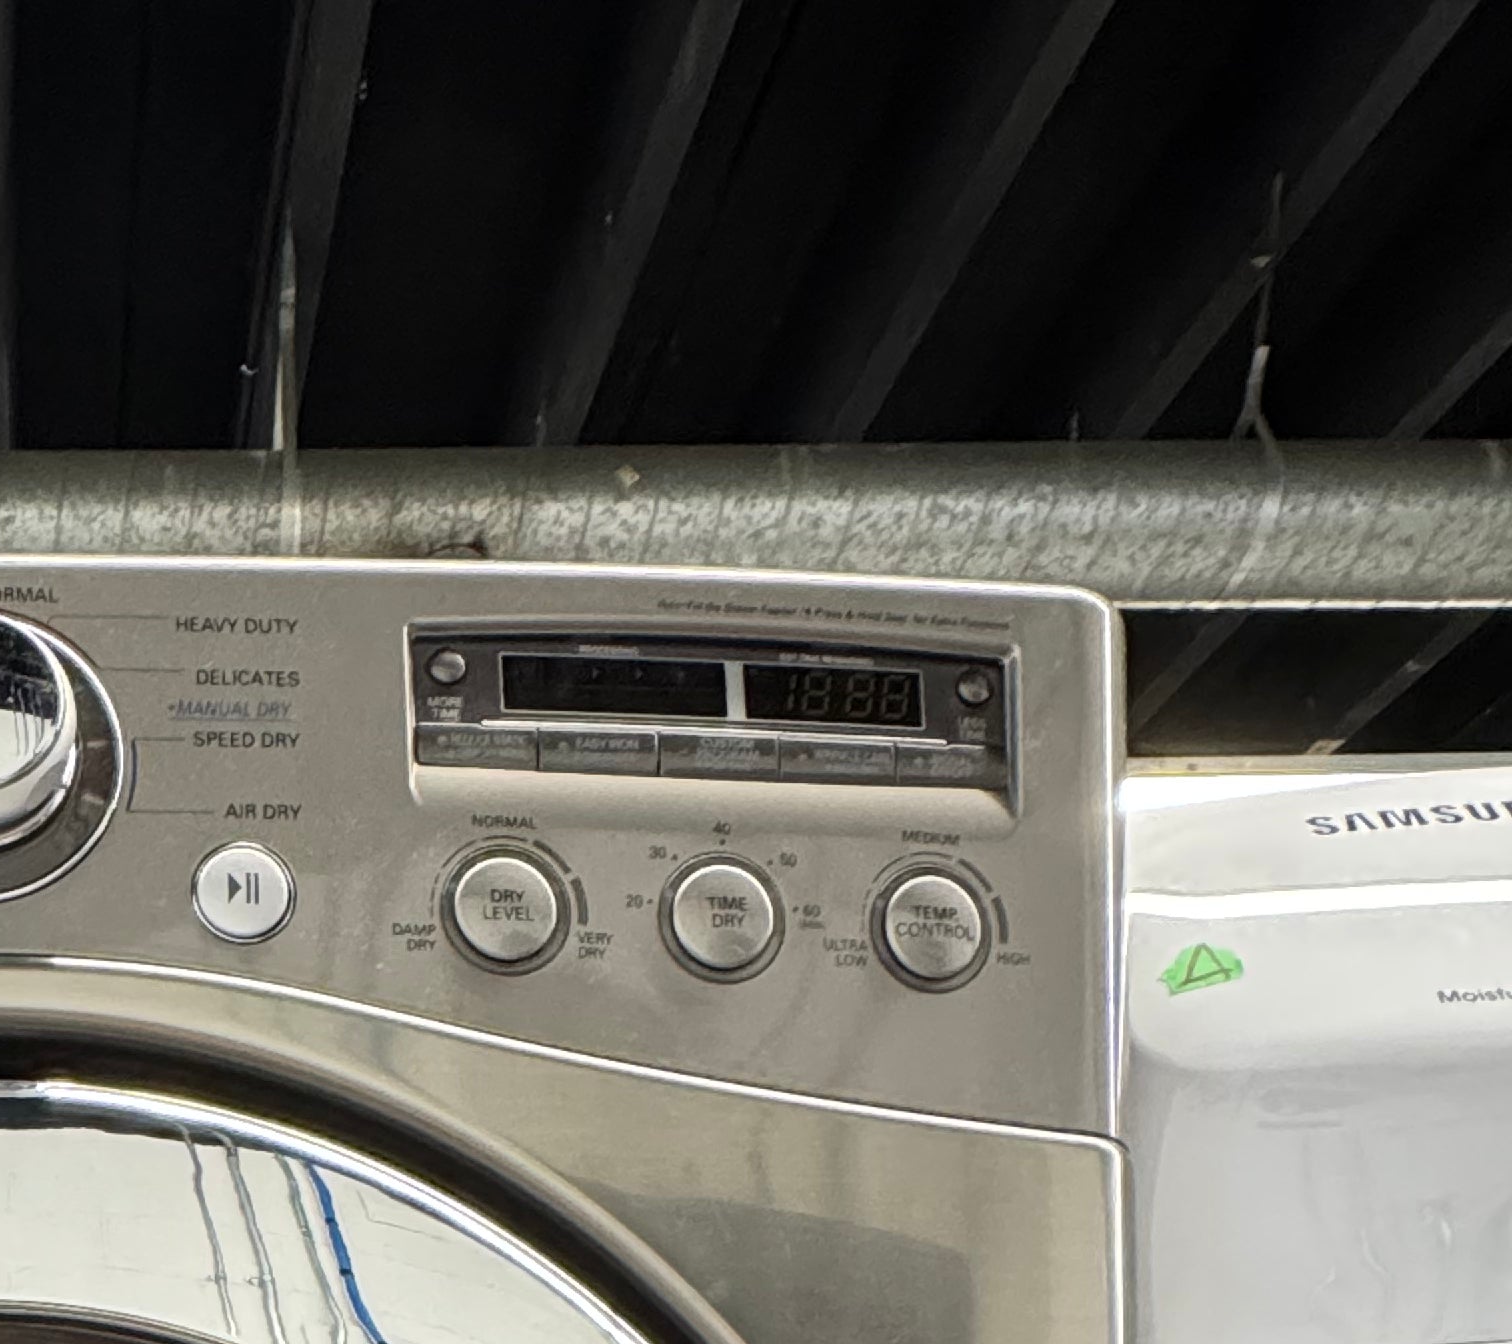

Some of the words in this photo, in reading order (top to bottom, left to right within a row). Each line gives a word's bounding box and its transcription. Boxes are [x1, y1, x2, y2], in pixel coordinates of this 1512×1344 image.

[175, 616, 238, 633] HEAVY
[244, 618, 299, 635] DUTY
[196, 669, 300, 687] DELICATES
[193, 731, 255, 748] SPEED
[261, 732, 300, 749] DRY
[224, 803, 257, 820] AIR
[263, 804, 302, 820] DRY
[471, 814, 537, 829] NORMAL
[712, 821, 731, 836] 40
[901, 830, 960, 846] MEDIUM
[649, 846, 667, 860] 30
[490, 888, 525, 904] DRY
[626, 894, 644, 909] 20
[705, 896, 748, 912] TIME
[482, 906, 535, 922] LEVEL
[712, 914, 745, 929] DRY
[392, 923, 437, 937] DAMP
[895, 923, 976, 941] CONTROL
[407, 938, 437, 952] DRY
[578, 931, 614, 946] VERY
[823, 937, 868, 952] ULTRA
[578, 946, 606, 960] DRY
[836, 954, 870, 969] LOW
